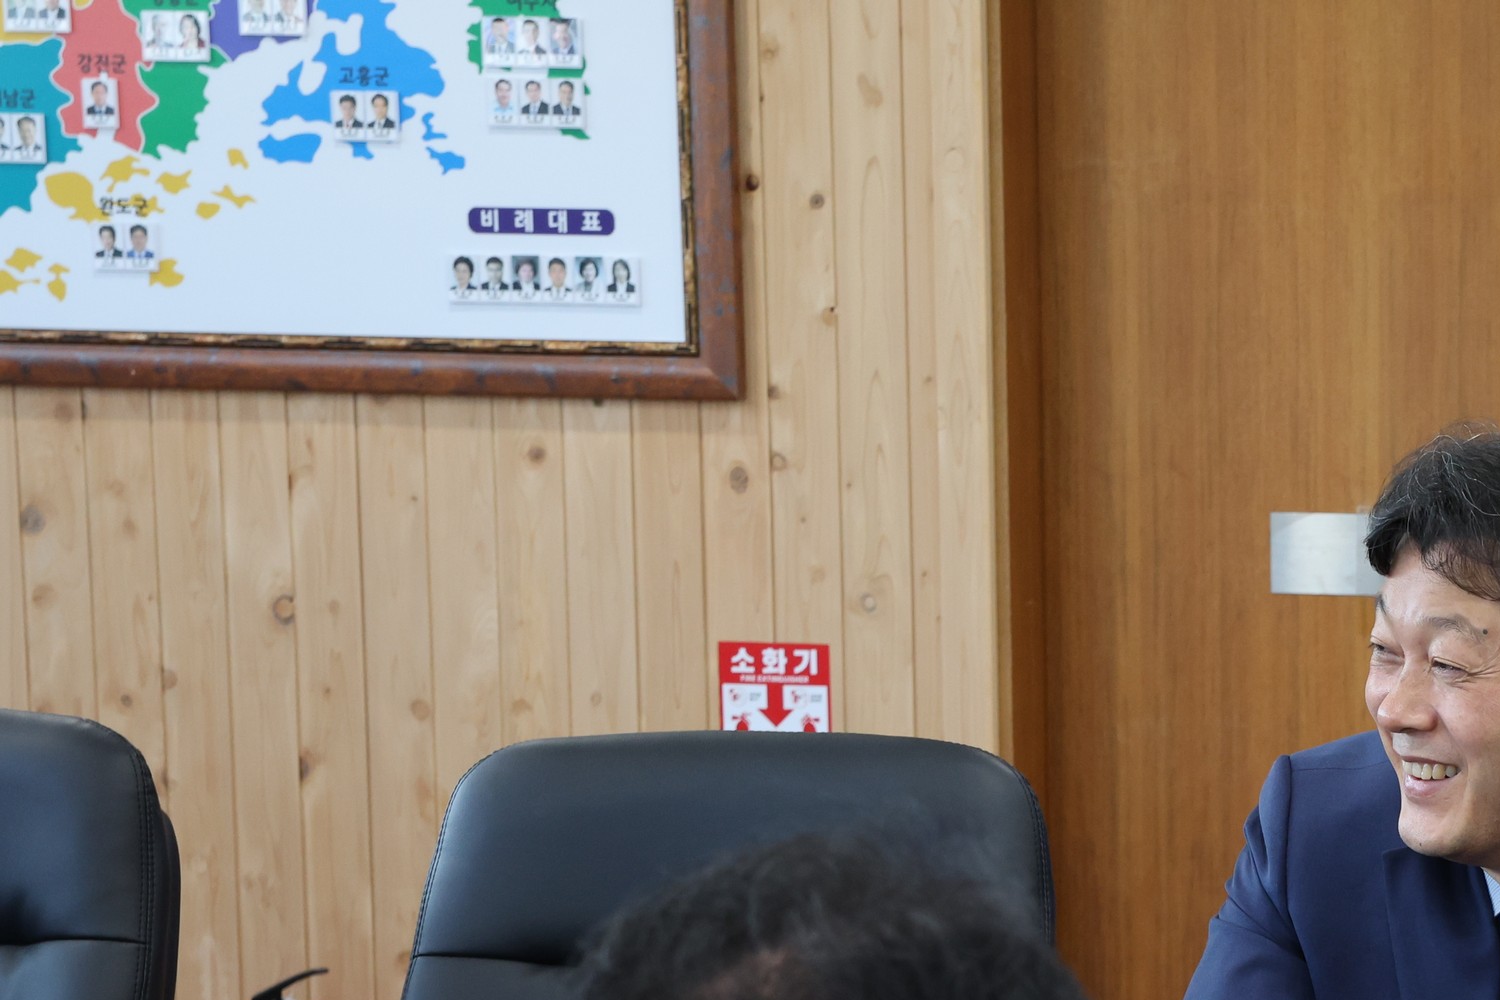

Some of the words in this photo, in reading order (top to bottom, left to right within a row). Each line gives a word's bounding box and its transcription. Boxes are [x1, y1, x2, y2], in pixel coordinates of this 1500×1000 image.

[77, 53, 127, 74] 강진군
[339, 65, 390, 87] 고흥군
[0, 88, 36, 109] 남군
[99, 196, 148, 217] 완도군
[480, 208, 603, 234] 비례대표
[730, 646, 819, 676] 소화기
